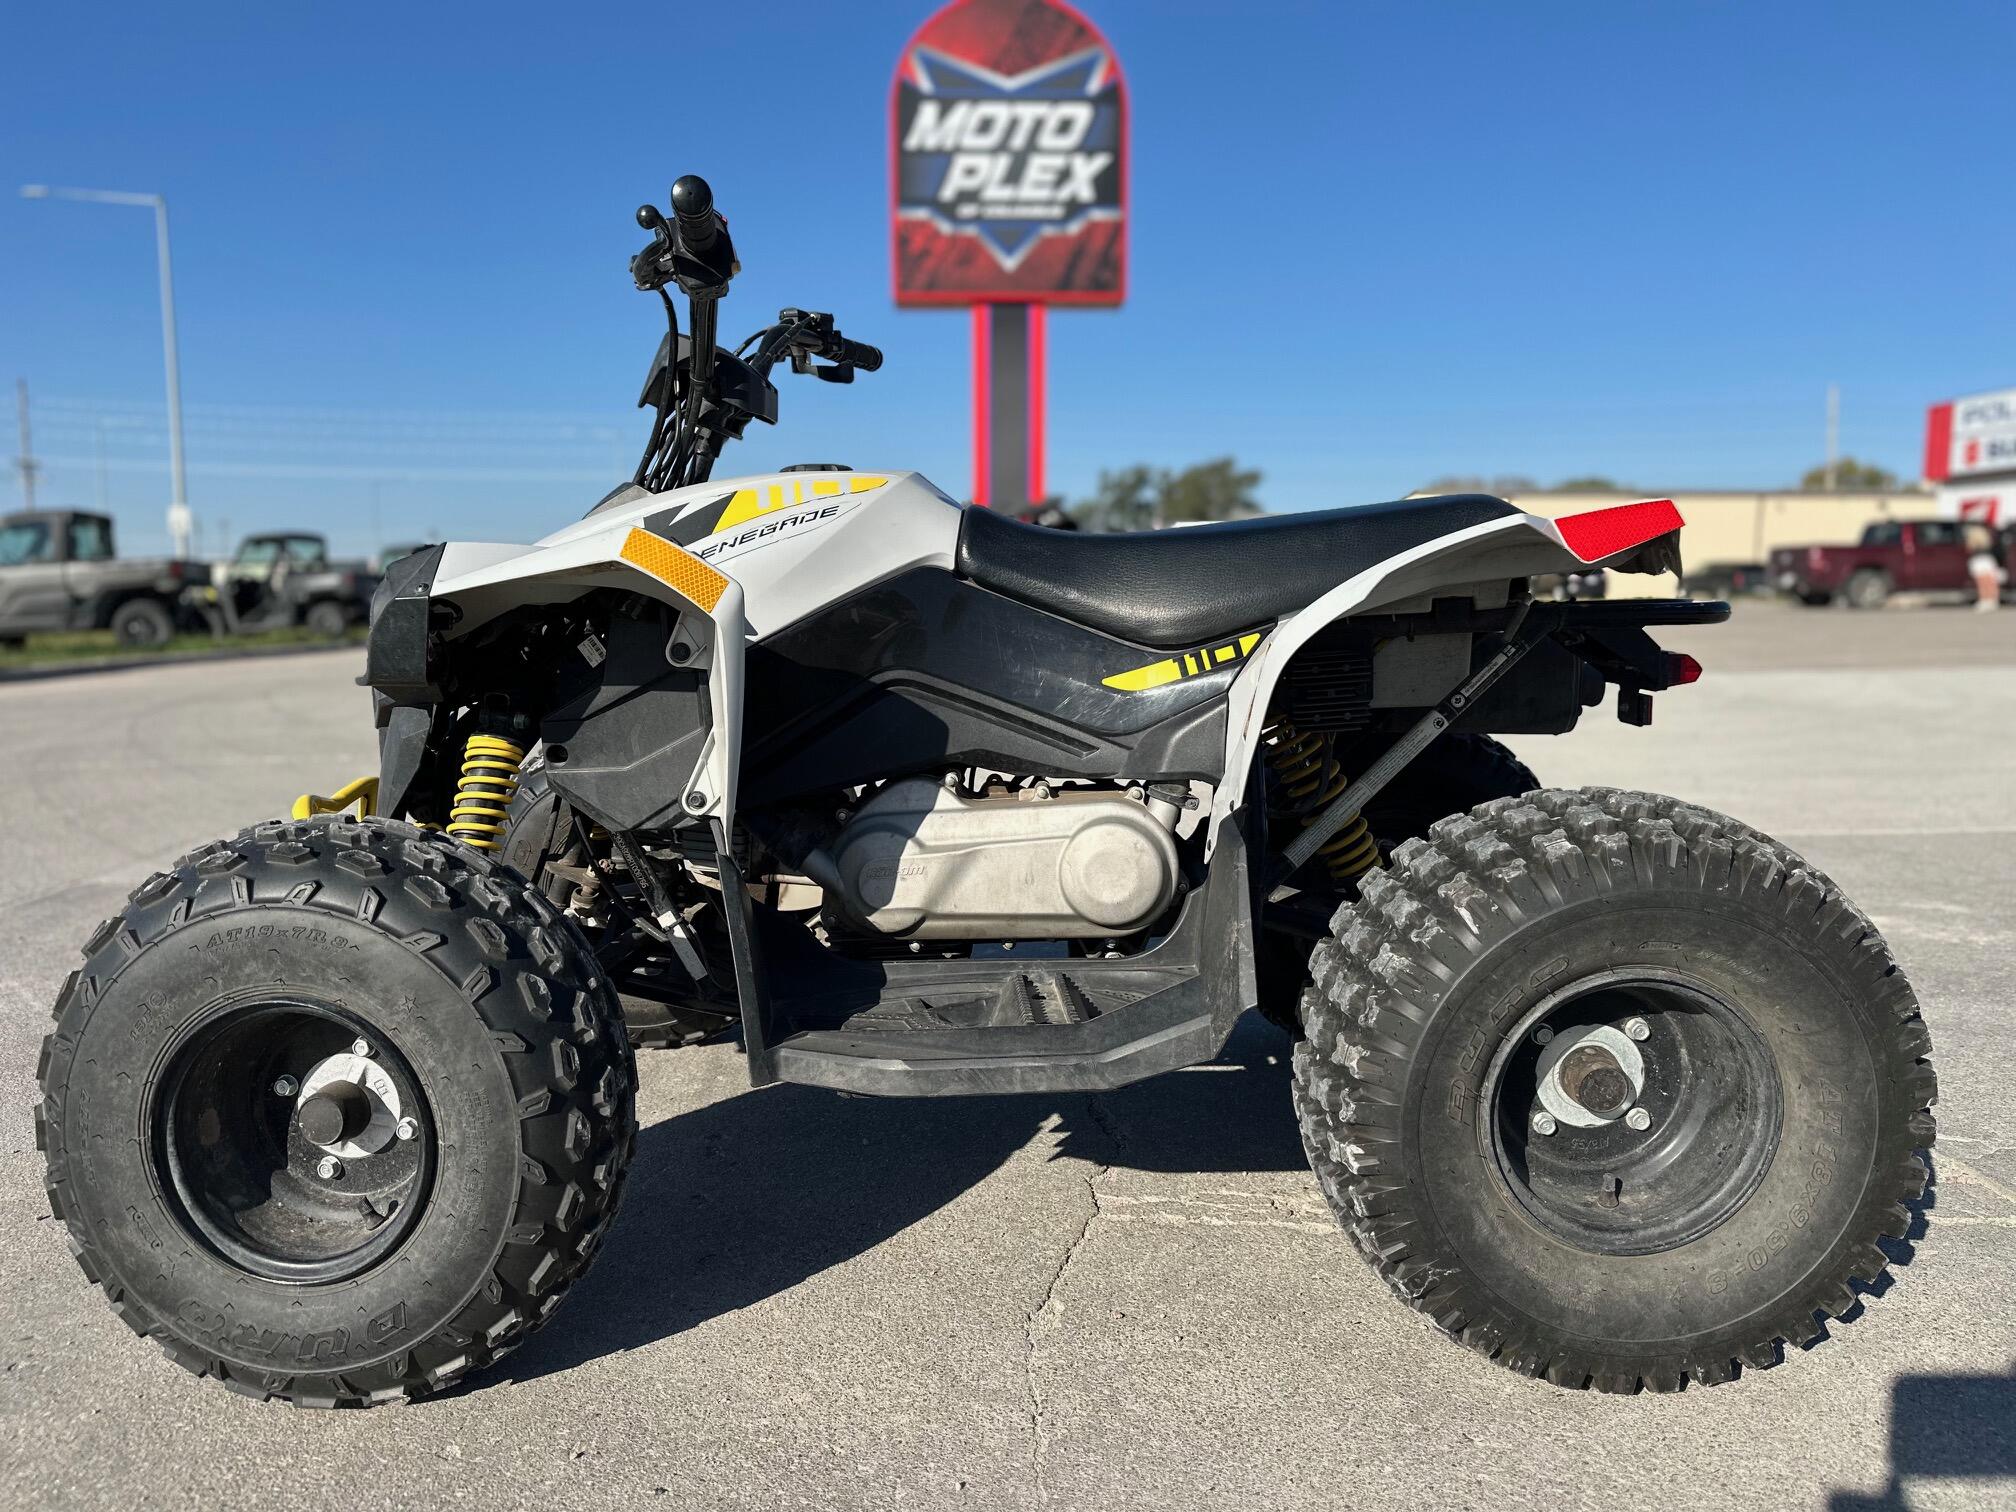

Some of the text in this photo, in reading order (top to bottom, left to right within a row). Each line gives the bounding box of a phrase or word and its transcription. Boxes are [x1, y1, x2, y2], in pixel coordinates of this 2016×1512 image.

[904, 100, 1095, 151] MOTO
[937, 151, 1113, 202] PLEX
[691, 504, 840, 560] ENEGADE
